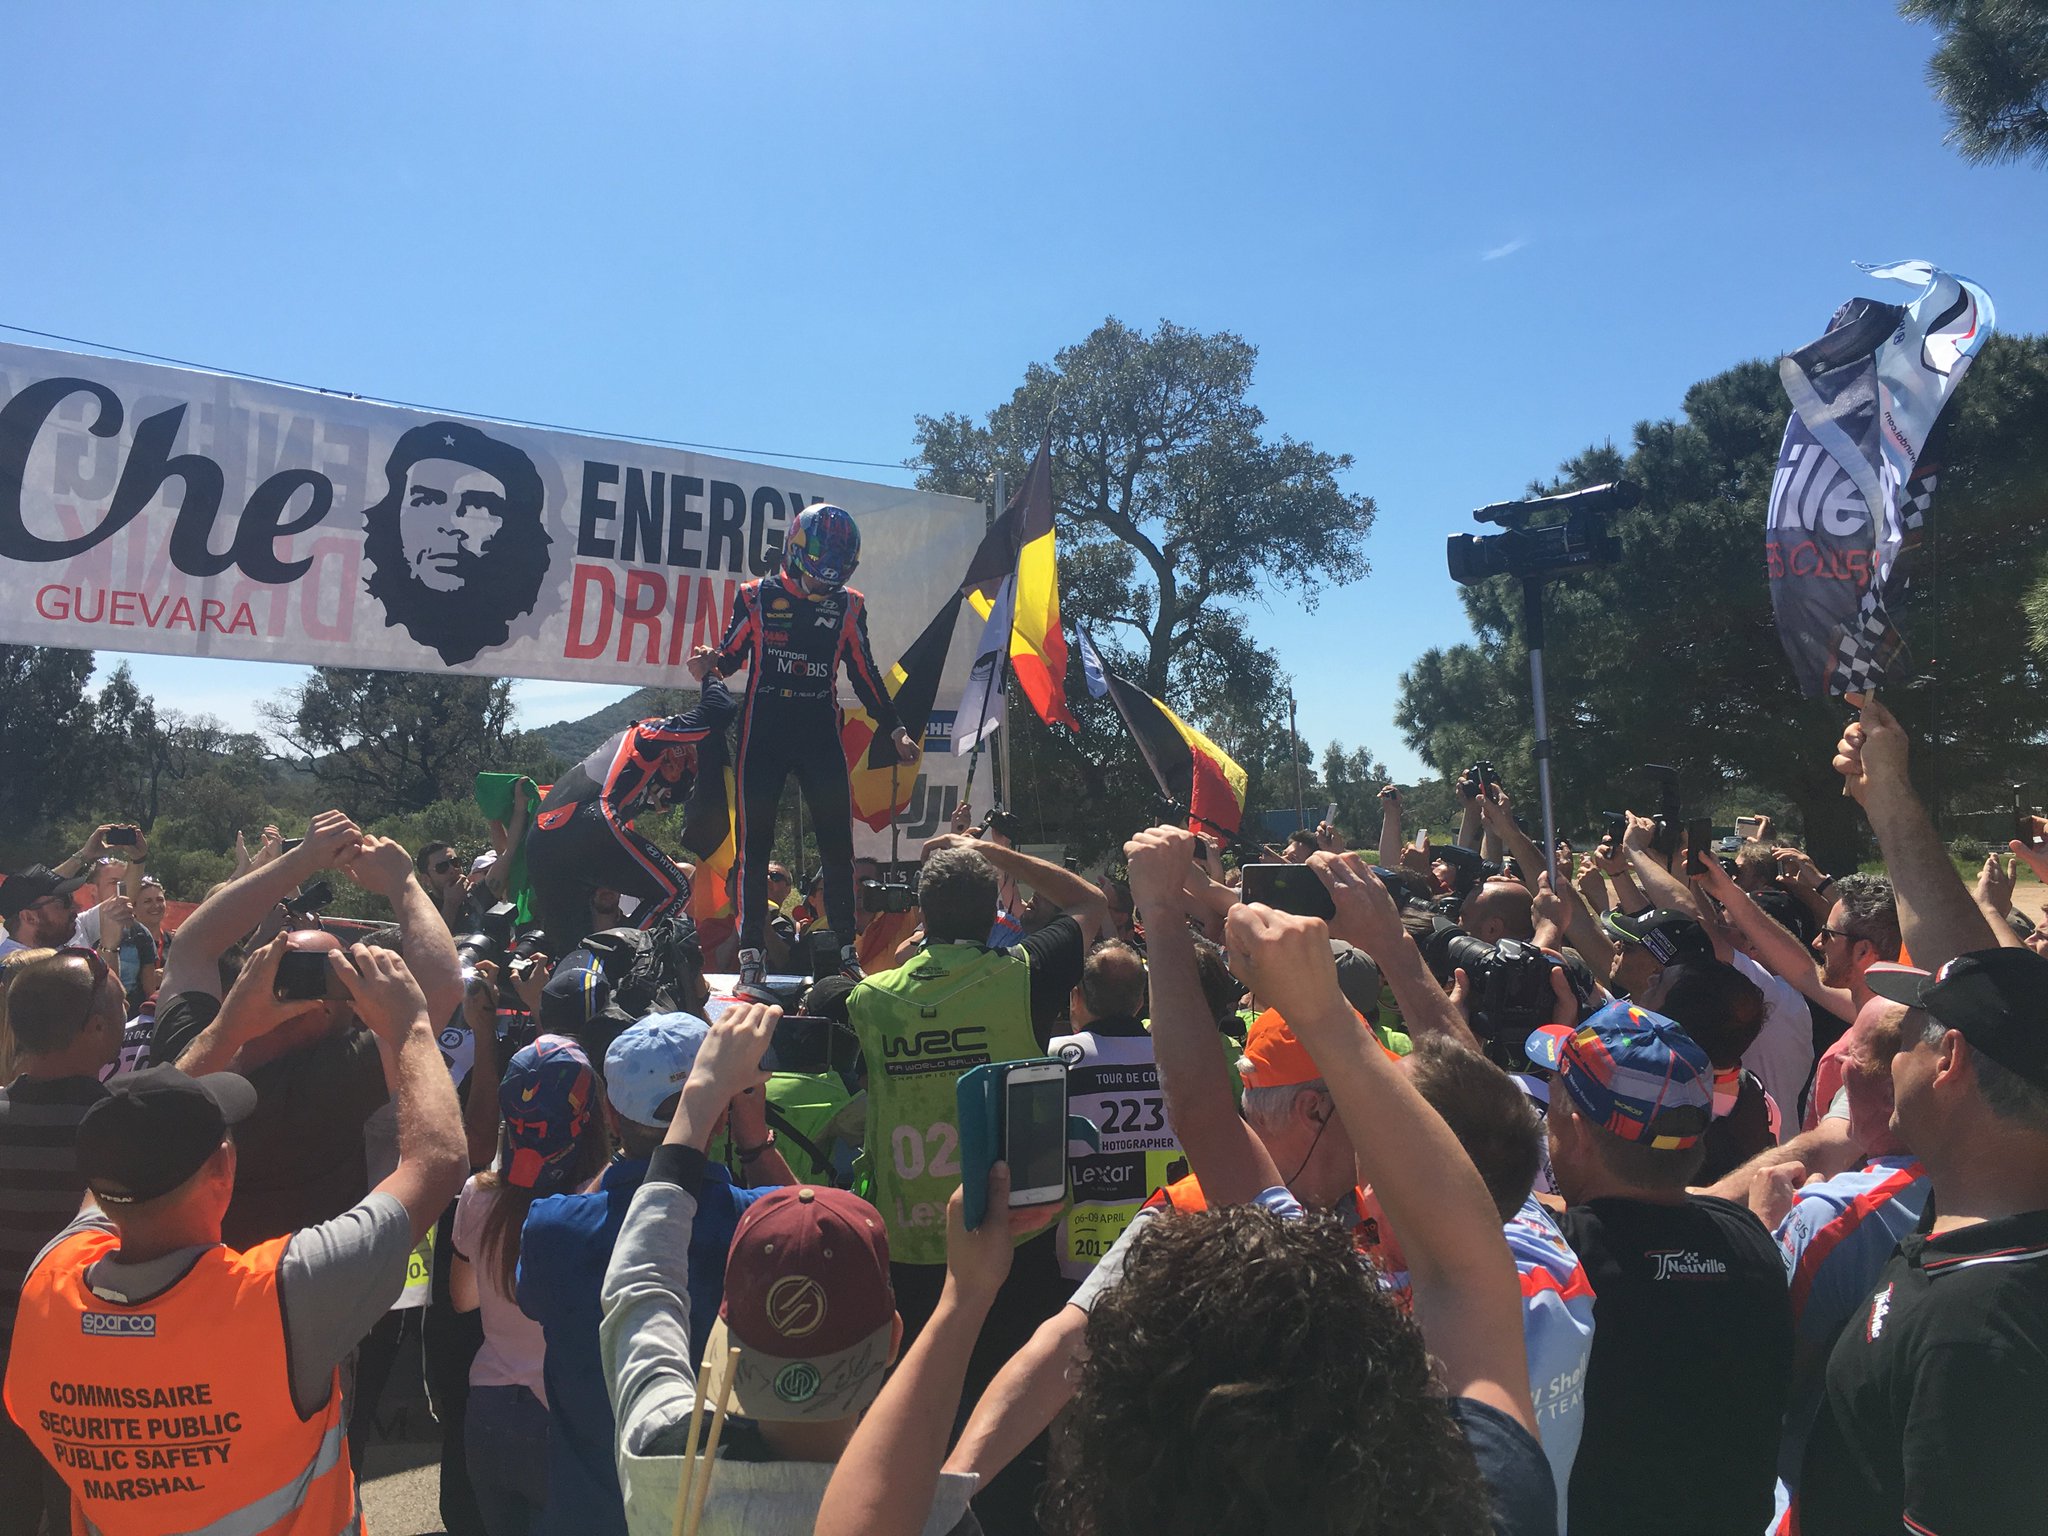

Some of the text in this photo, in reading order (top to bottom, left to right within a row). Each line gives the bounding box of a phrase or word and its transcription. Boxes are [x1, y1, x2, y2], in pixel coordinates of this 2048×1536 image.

[0, 376, 333, 584] Che
[35, 584, 258, 636] GUEVARA
[564, 563, 737, 666] DRIN
[768, 648, 807, 660] HYUNDAI
[777, 658, 828, 677] MOBIS
[882, 1026, 987, 1058] WRC
[1063, 1049, 1080, 1060] FRA
[1096, 1072, 1123, 1084] TOUR
[1126, 1071, 1139, 1083] DE
[1100, 1098, 1165, 1134] 223
[891, 1122, 961, 1180] 02
[1101, 1138, 1174, 1151] HOTOGRAPHER
[1072, 1165, 1134, 1186] Lexar
[1075, 1213, 1126, 1225] 06-09 APRIL
[82, 1313, 155, 1334] sparco
[50, 1381, 213, 1408] COMMISSAIRE
[38, 1409, 242, 1440] SECURITE PUBLIC
[53, 1442, 231, 1471] PUBLIC SAFETY
[83, 1476, 205, 1501] MARSHAL
